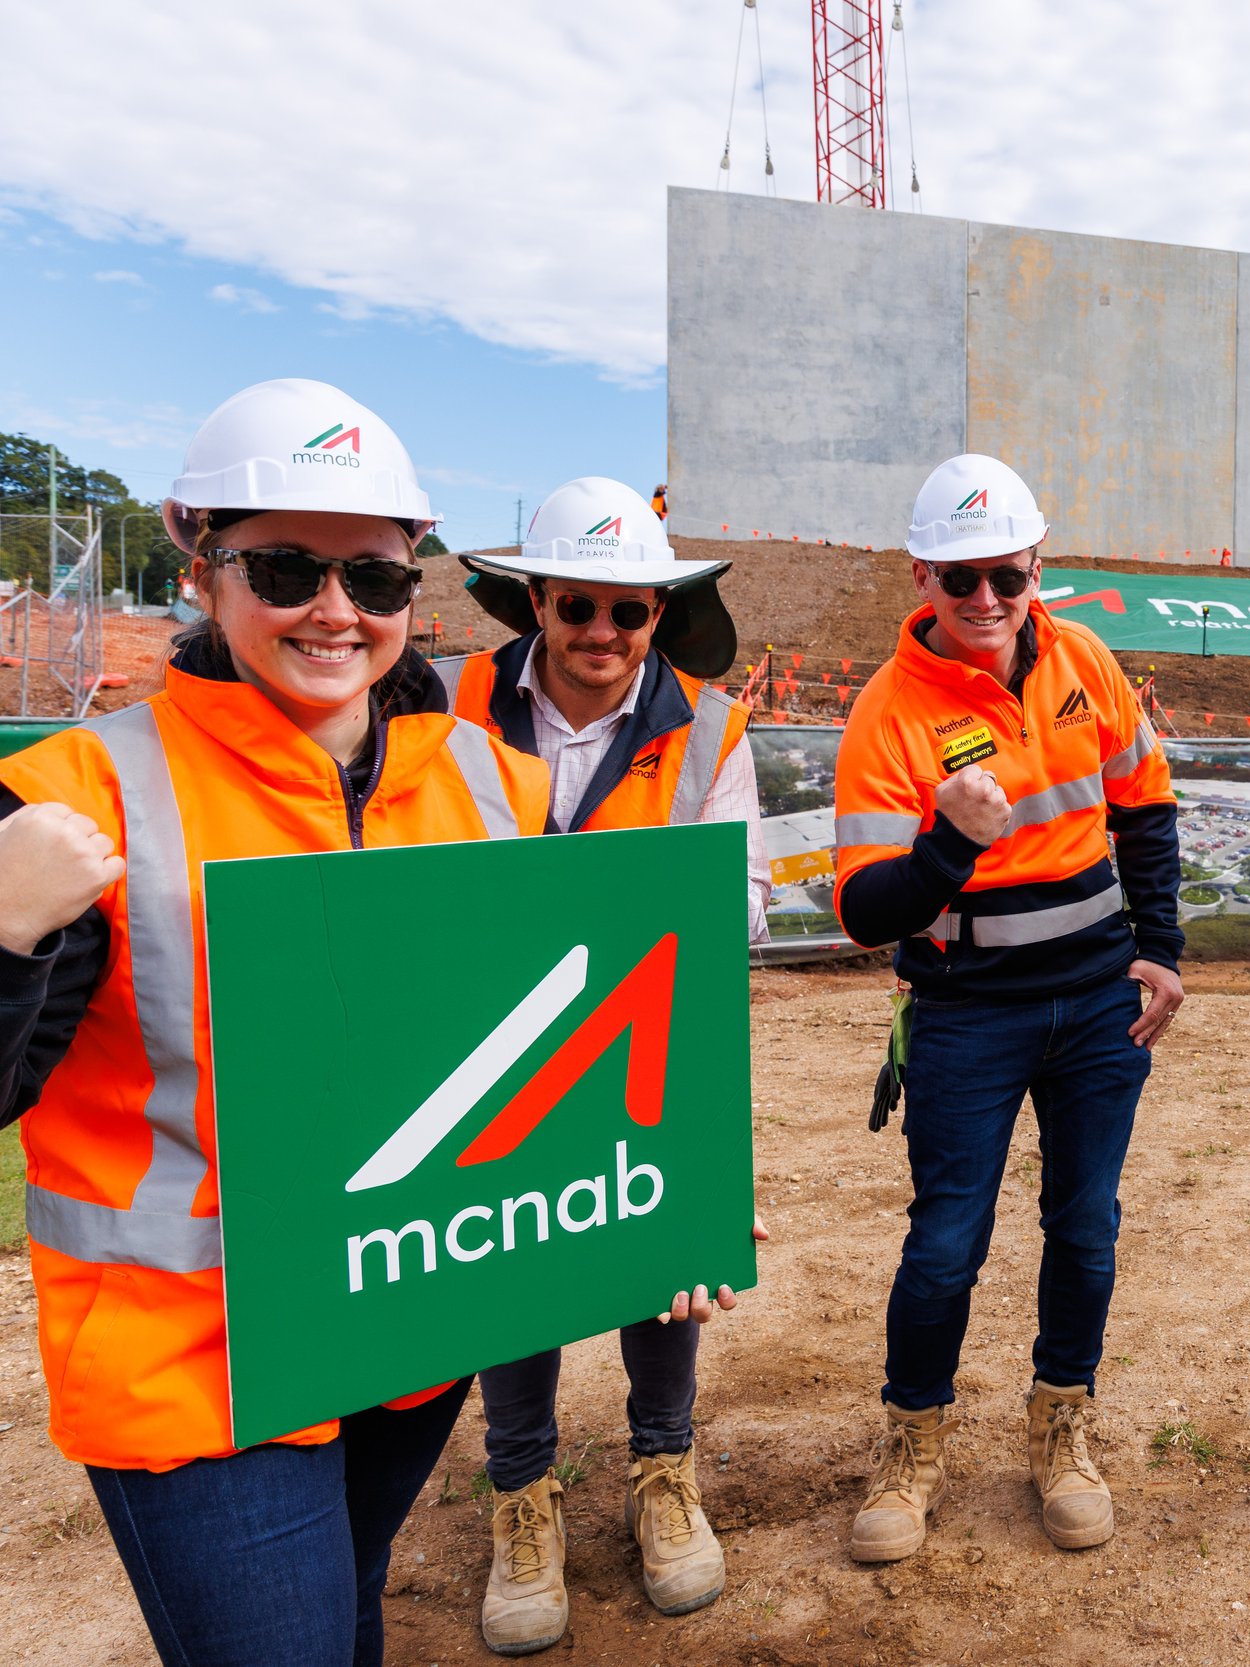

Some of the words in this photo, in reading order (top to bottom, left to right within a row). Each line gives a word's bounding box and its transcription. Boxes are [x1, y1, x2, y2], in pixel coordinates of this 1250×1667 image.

[292, 452, 360, 468] mcnab
[950, 508, 987, 521] mcnab
[578, 536, 619, 547] mcnab
[934, 715, 974, 737] Nathan
[1053, 710, 1092, 730] mcnab
[955, 739, 972, 749] safety
[973, 732, 986, 743] first
[950, 755, 971, 769] quality
[971, 746, 993, 758] always
[346, 1140, 664, 1293] mcnab
